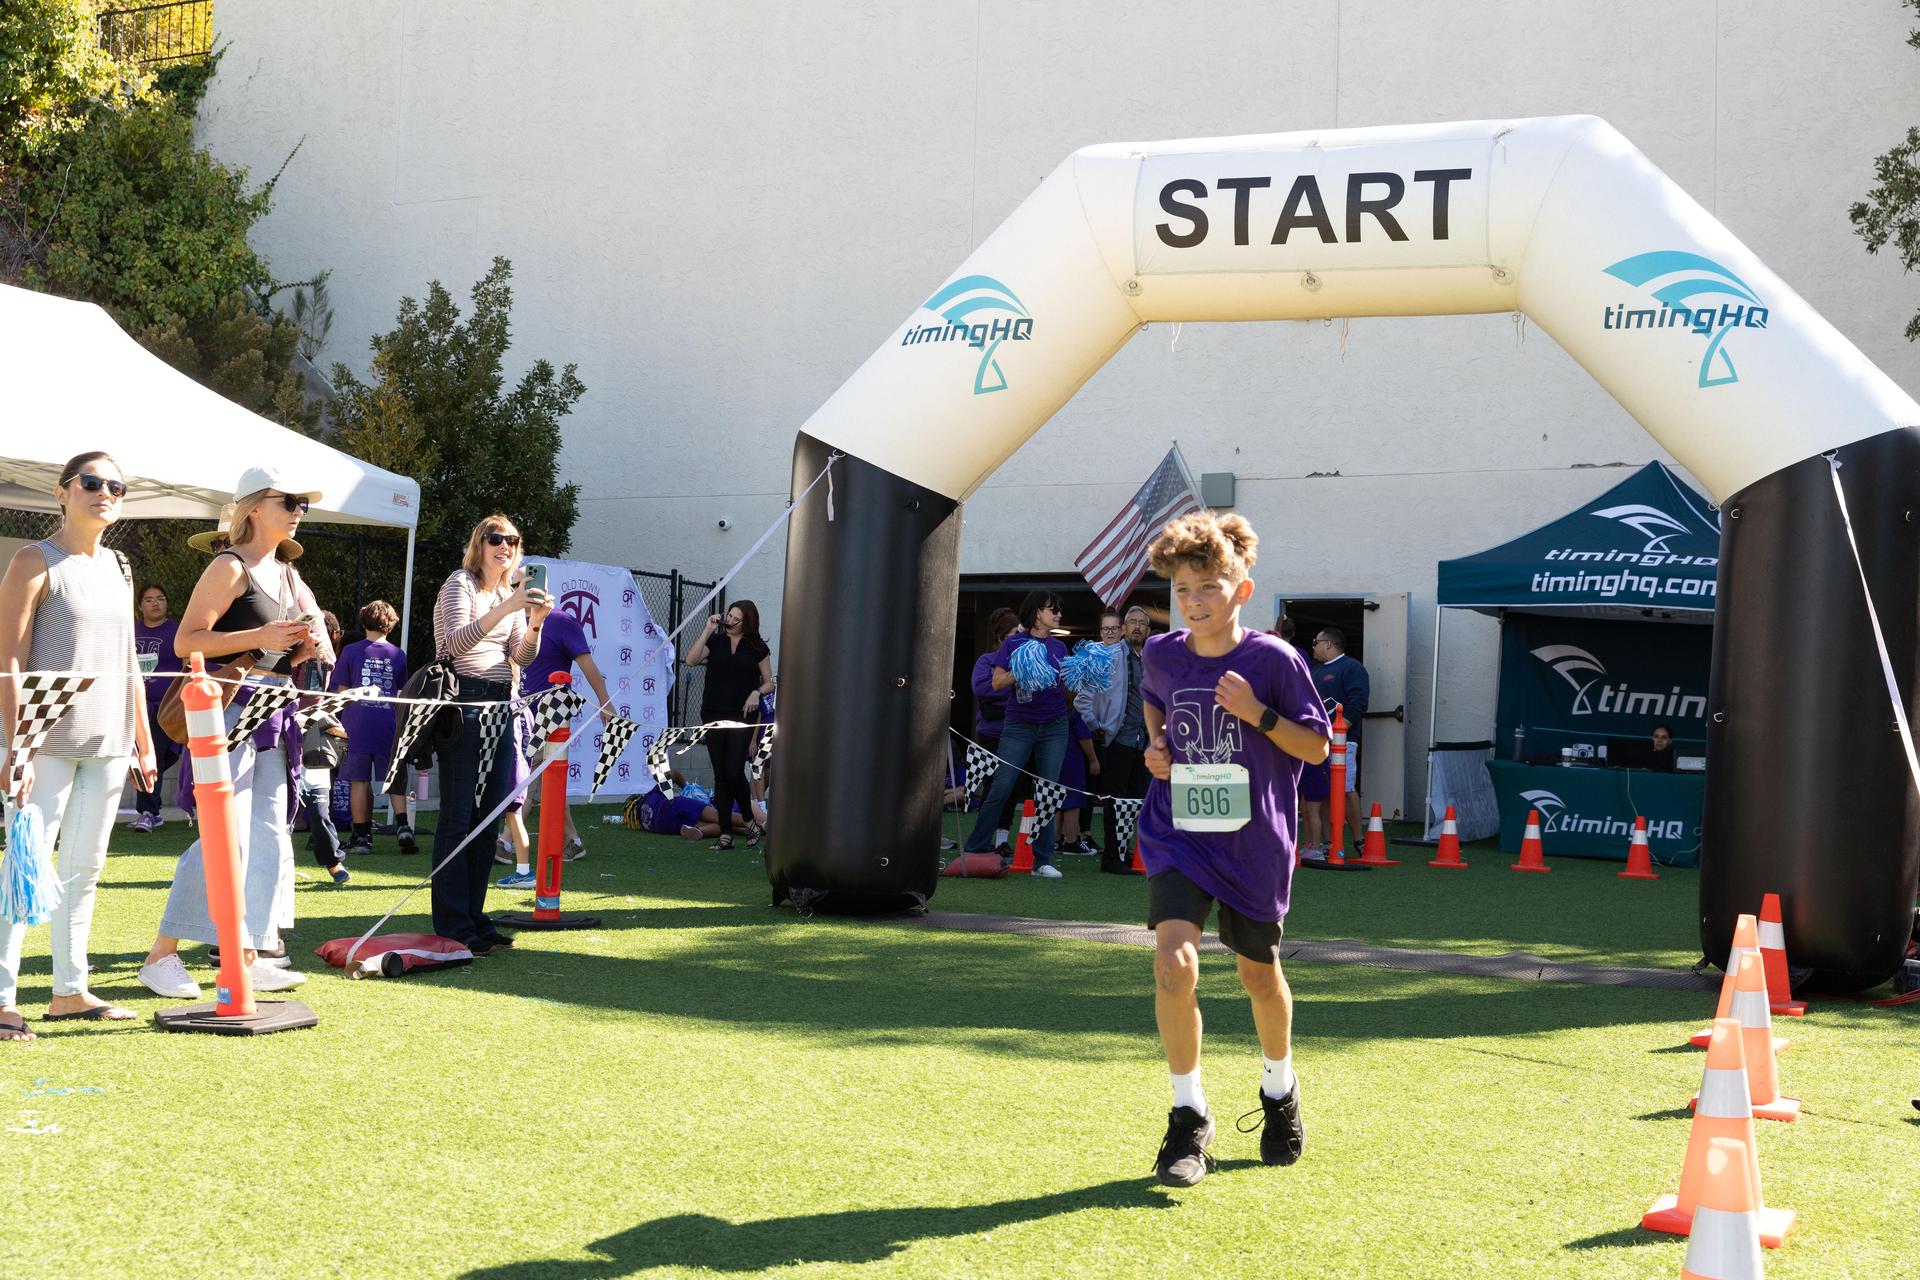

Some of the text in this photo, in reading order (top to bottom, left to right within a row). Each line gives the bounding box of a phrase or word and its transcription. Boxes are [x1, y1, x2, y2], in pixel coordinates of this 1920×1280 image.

[1155, 168, 1472, 248] START
[1603, 301, 1769, 334] timingHQ
[901, 318, 1034, 347] timingHQ
[1545, 549, 1718, 567] timingHQ
[561, 580, 577, 593] OLD
[140, 661, 152, 671] 78
[1187, 787, 1230, 816] 696
